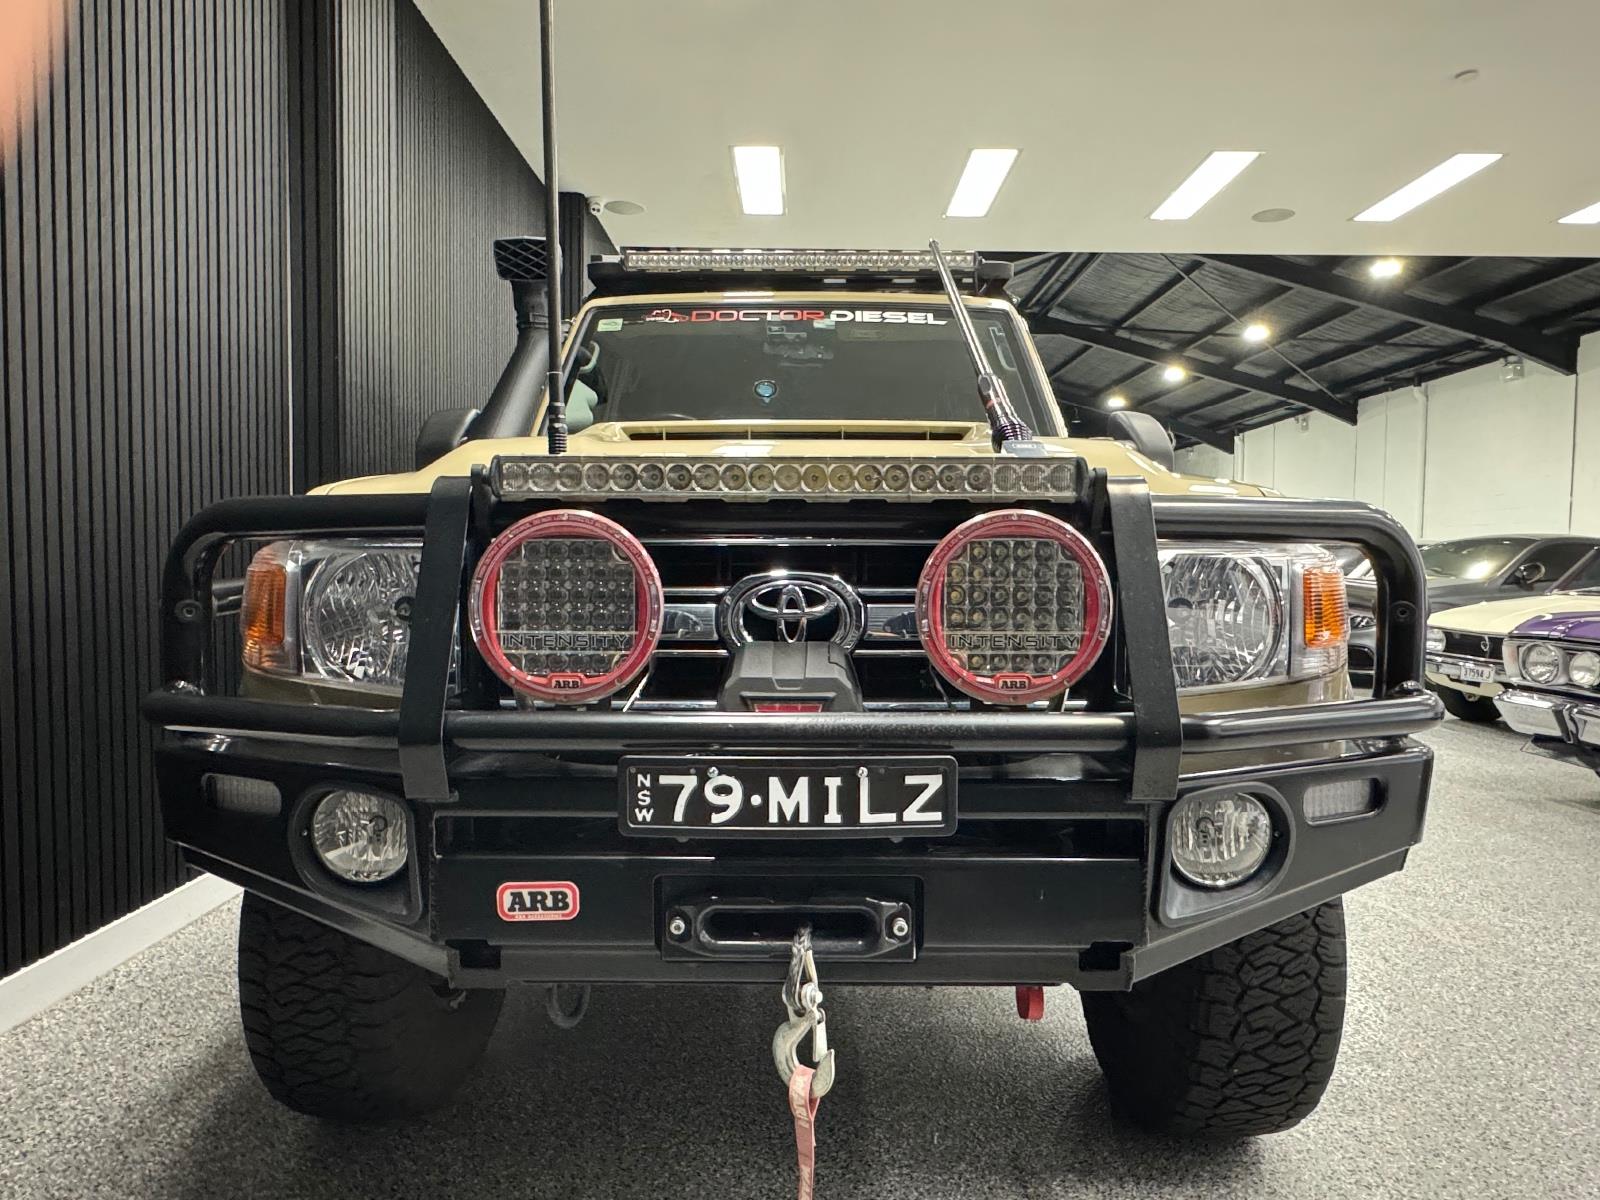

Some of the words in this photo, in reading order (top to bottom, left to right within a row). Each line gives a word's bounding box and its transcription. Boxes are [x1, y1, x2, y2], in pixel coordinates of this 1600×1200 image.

[691, 310, 825, 323] DOCTOR
[829, 311, 948, 325] DIESEL
[502, 634, 628, 648] INTENSITY
[951, 634, 1079, 648] INTENSITY
[553, 680, 580, 689] ARB
[1000, 681, 1027, 689] ARB
[507, 890, 569, 912] ARB
